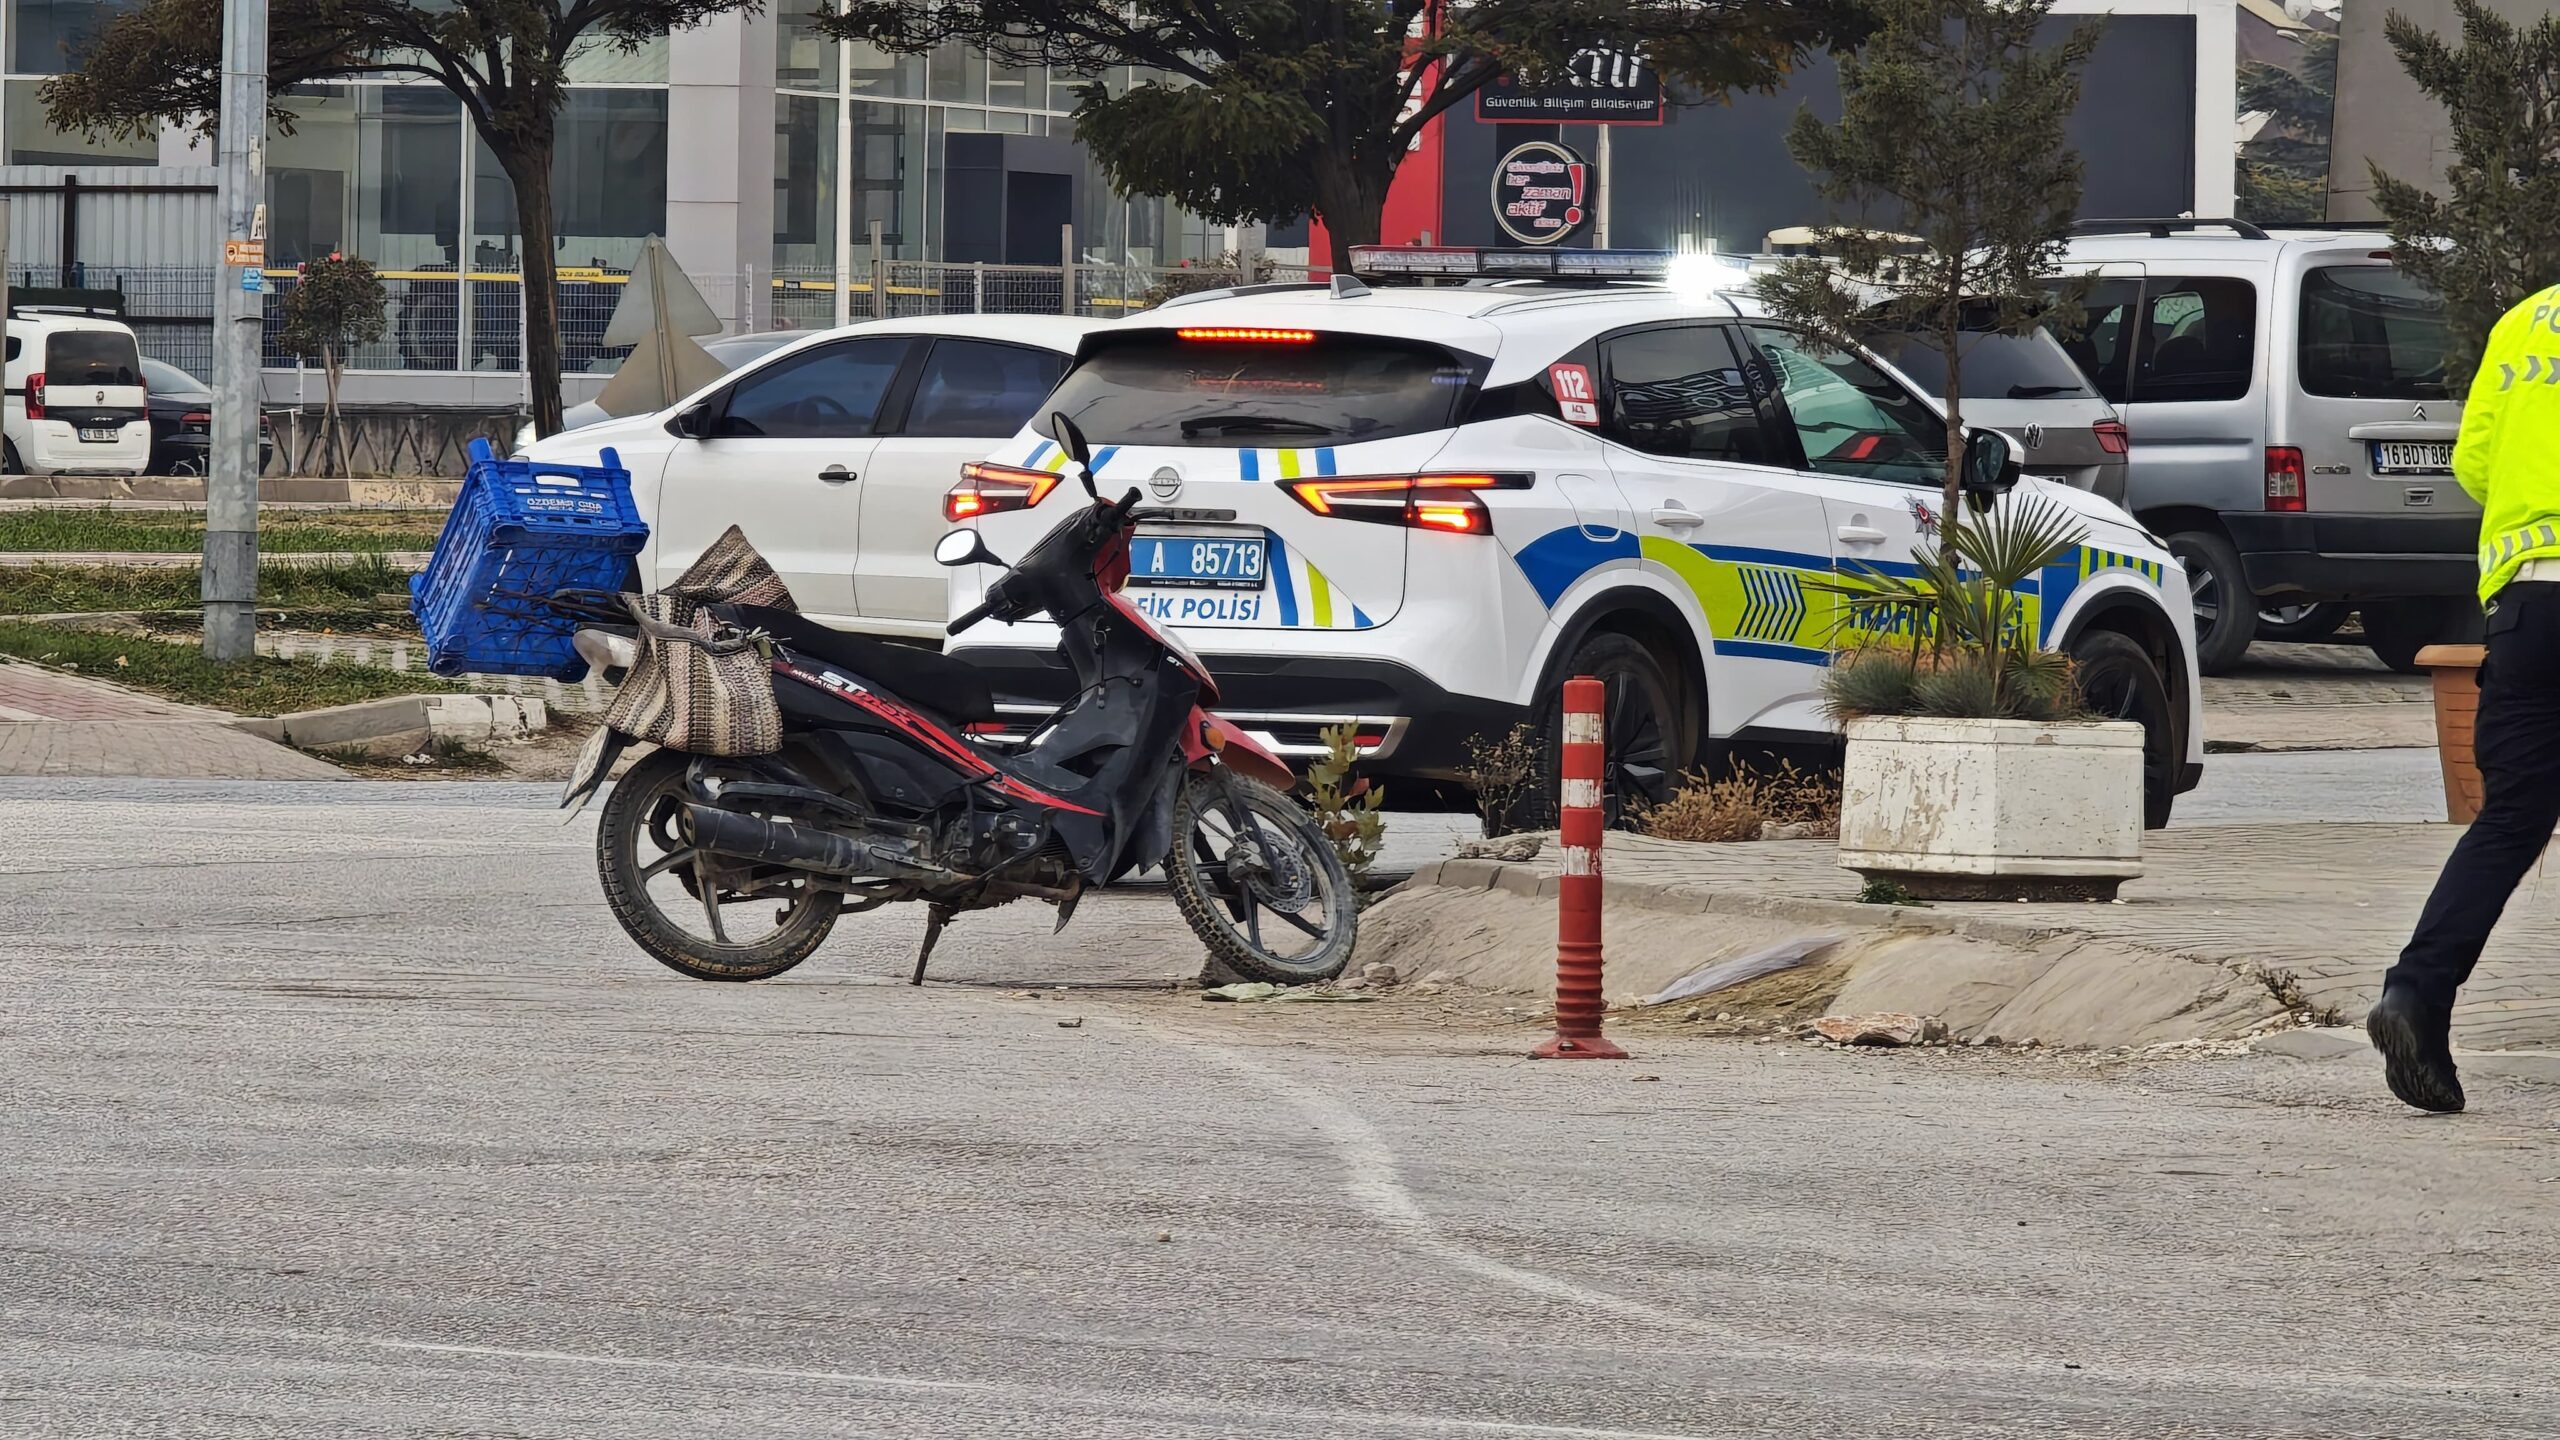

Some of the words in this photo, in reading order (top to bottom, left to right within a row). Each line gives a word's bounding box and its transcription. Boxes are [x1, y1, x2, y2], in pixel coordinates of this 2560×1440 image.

[1486, 96, 1537, 108] Güvenlik
[1543, 97, 1584, 112] Bilişim
[1522, 187, 1571, 199] zaman
[1507, 201, 1546, 216] aktif
[1555, 369, 1589, 399] 112
[2384, 445, 2400, 465] 16
[2403, 445, 2427, 465] BDT
[1151, 541, 1165, 573] A
[1191, 543, 1260, 576] 85713
[1181, 593, 1261, 621] POLİSİ
